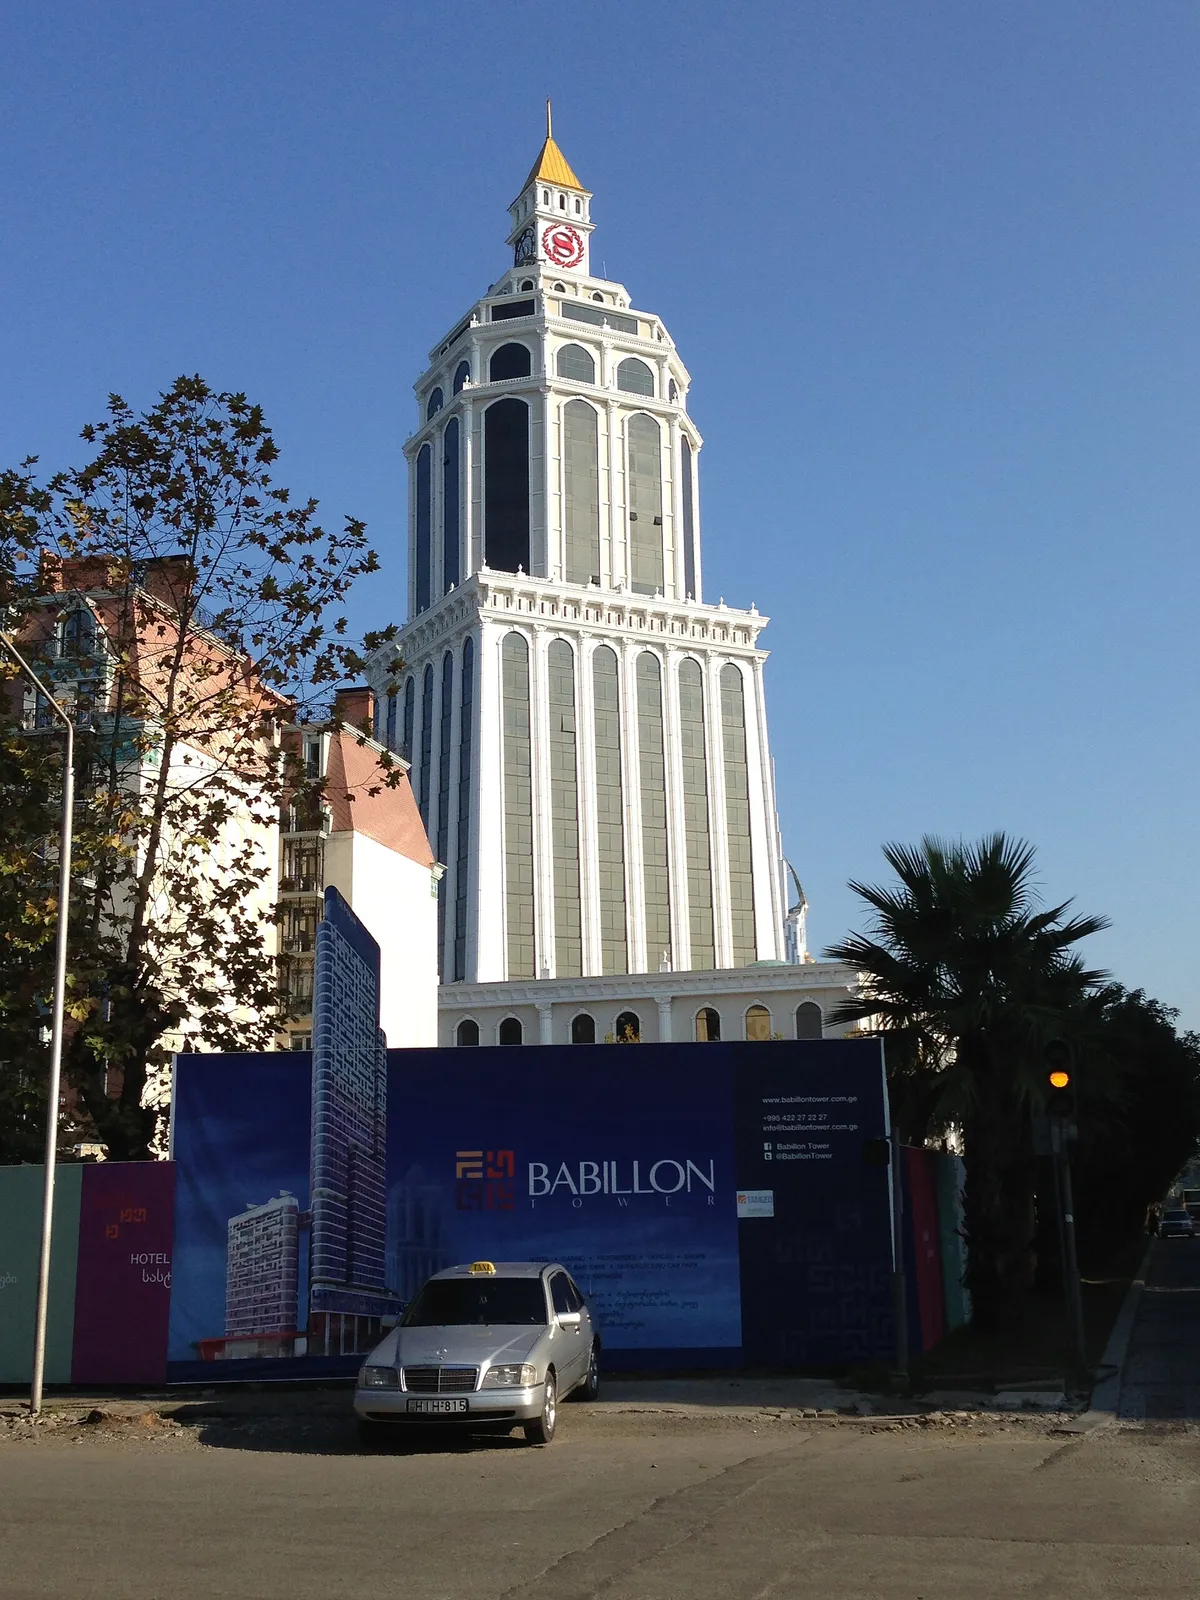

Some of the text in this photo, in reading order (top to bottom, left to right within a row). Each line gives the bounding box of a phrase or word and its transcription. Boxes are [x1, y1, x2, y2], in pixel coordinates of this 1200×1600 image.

[761, 1095, 858, 1104] www.babillontower.com.ge
[818, 1113, 828, 1121] 27
[762, 1123, 858, 1132] info@babillontower.com.ge
[807, 1142, 830, 1150] Tower
[528, 1159, 715, 1196] BABILLON
[530, 1195, 716, 1209] TOWER
[130, 1253, 171, 1265] HOTEL
[473, 1263, 491, 1272] TAXI
